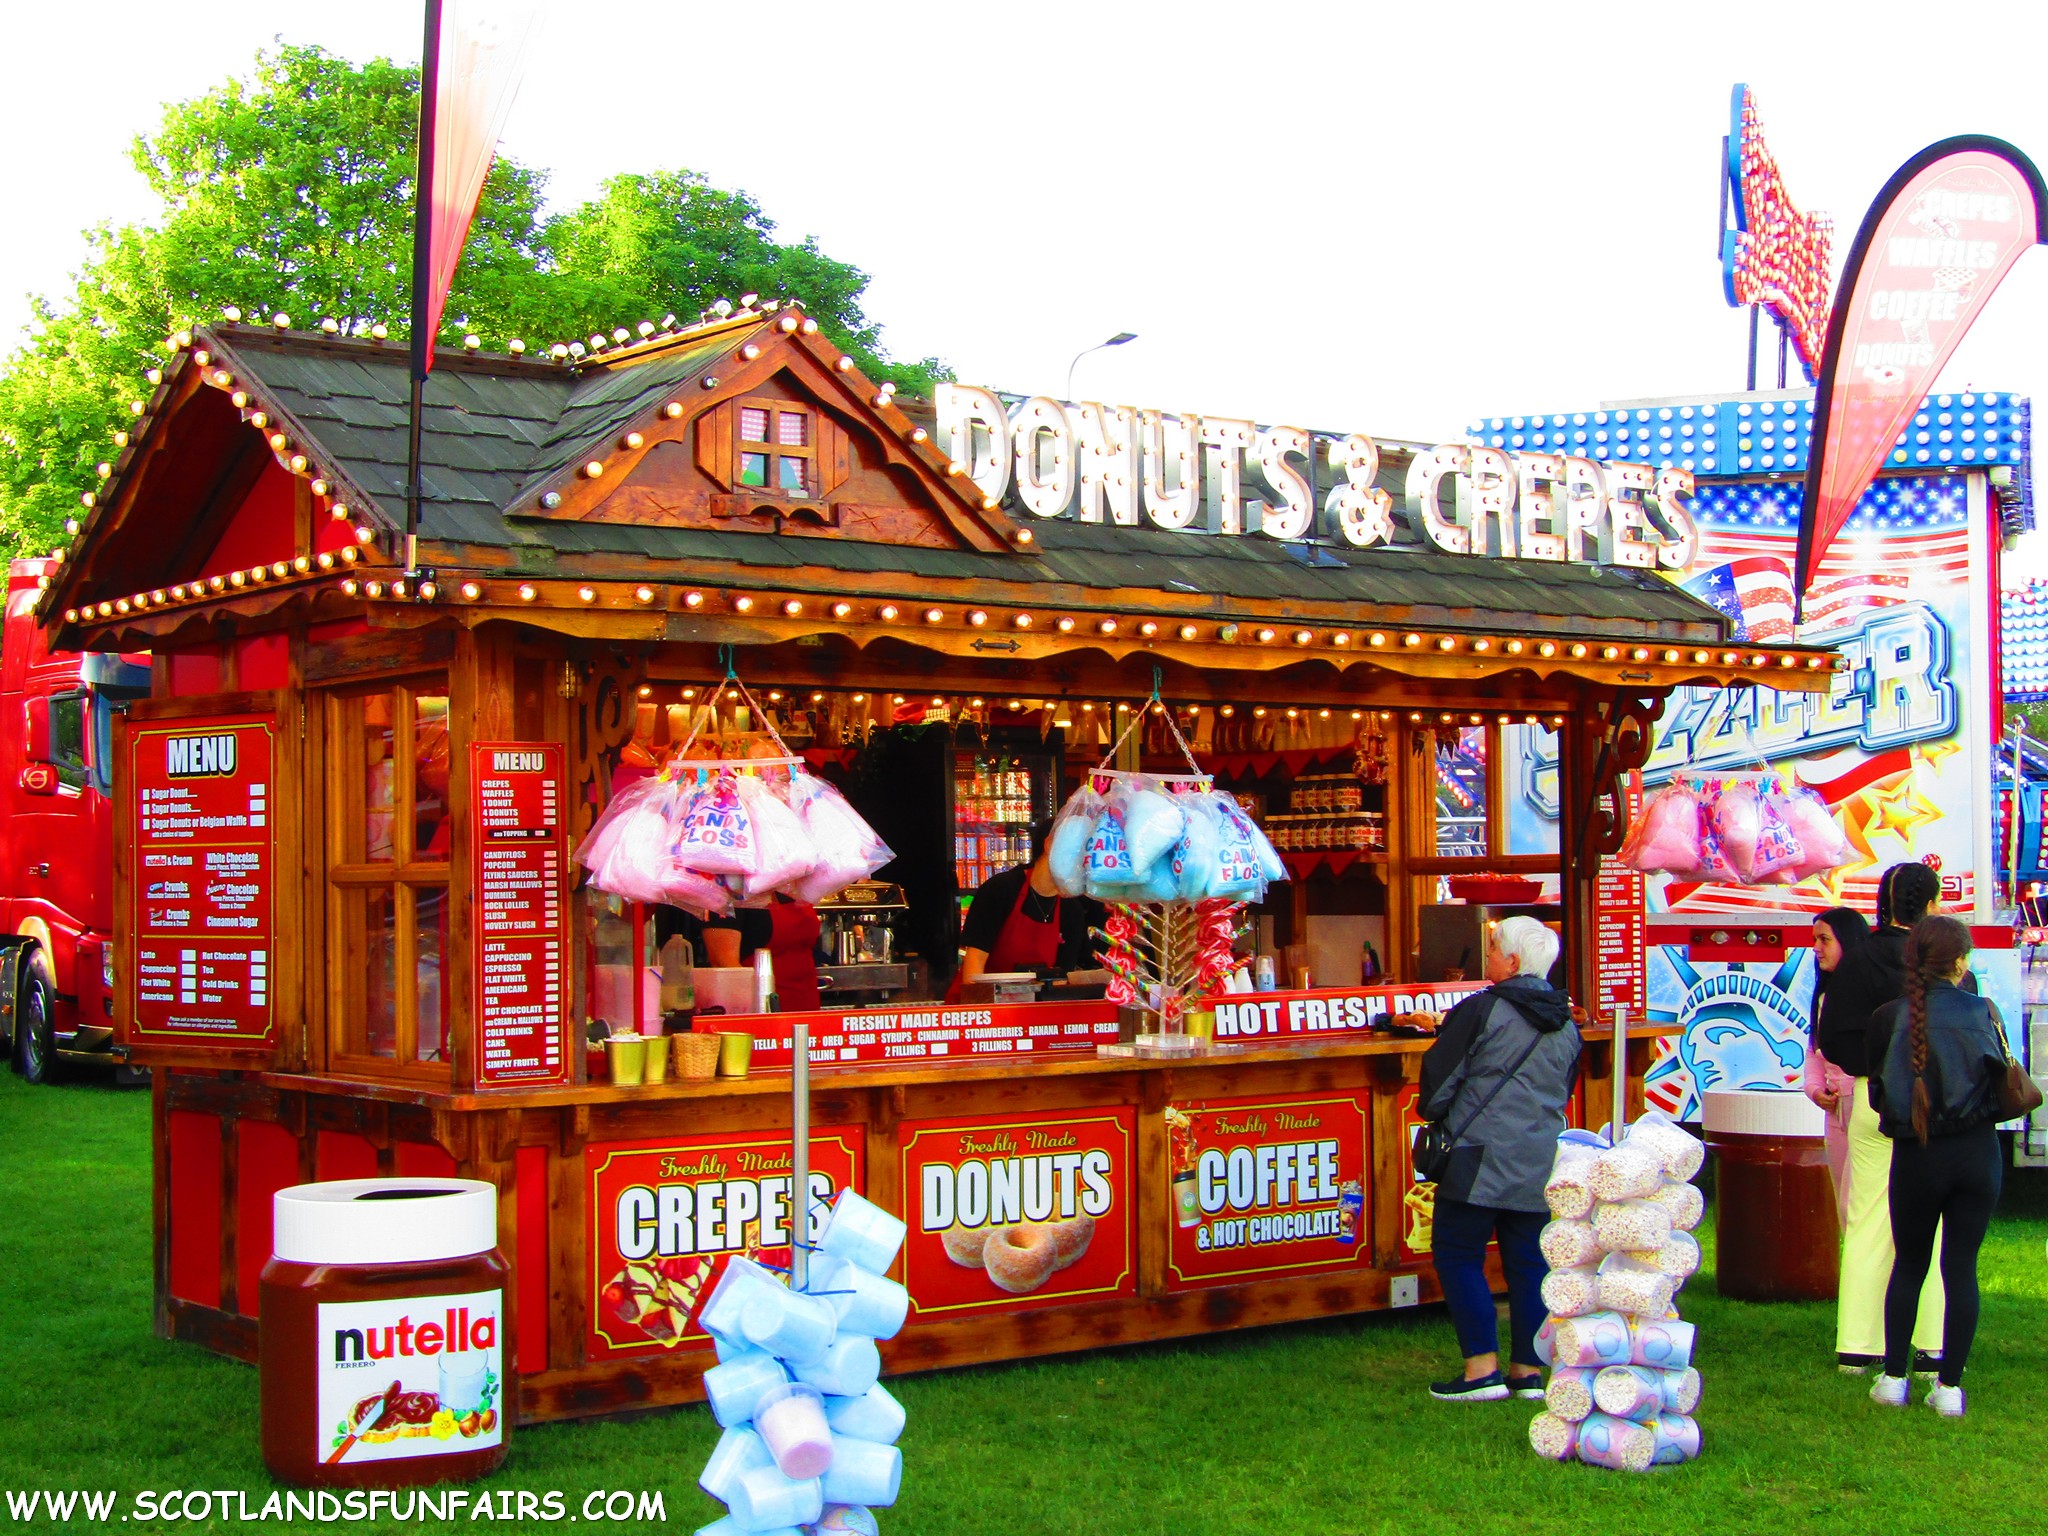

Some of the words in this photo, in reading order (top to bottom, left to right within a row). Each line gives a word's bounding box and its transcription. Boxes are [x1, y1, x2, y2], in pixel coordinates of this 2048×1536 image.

[1925, 191, 2013, 222] CREPES
[1887, 237, 1997, 268] WAFFLES
[1870, 290, 1956, 320] COFFEE
[1855, 342, 1934, 367] DONUTS
[935, 382, 1313, 539] DONUTS
[1325, 433, 1395, 546] &
[1405, 443, 1699, 570] CREPES
[168, 735, 235, 774] MENU
[493, 752, 544, 771] MENU
[482, 780, 510, 788] CREPES
[152, 788, 169, 800] Sugar
[482, 789, 514, 798] WAFFLES
[482, 799, 487, 807] 1
[488, 799, 513, 807] DONUT
[152, 803, 169, 815] Sugar
[488, 808, 518, 817] DONUTS
[152, 818, 169, 829] Sugar
[170, 817, 191, 828] Donuts
[192, 819, 199, 828] or
[226, 815, 247, 827] Waffle
[483, 818, 488, 826] 3
[489, 818, 519, 826] DONUTS
[684, 811, 748, 832] CANDY
[680, 829, 748, 849] FLOSS
[1085, 835, 1126, 852] CAN
[207, 853, 225, 864] White
[226, 852, 259, 863] Chocolate
[483, 850, 526, 859] CANDYFLOSS
[1219, 848, 1256, 864] CAN
[167, 857, 172, 866] &
[172, 855, 193, 866] Cream
[484, 861, 516, 869] POPCORN
[1082, 852, 1132, 869] FLOS
[484, 871, 506, 880] FLYING
[506, 870, 538, 879] SAUCERS
[165, 881, 188, 892] Crumbs
[227, 883, 259, 895] Chocolate
[484, 881, 508, 890] MARSH
[509, 880, 543, 889] MALLOWS
[484, 891, 517, 900] DUMMIES
[484, 902, 504, 910] ROCK
[504, 901, 530, 909] LOLLIES
[167, 909, 190, 920] Crumbs
[484, 912, 507, 920] SLUSH
[206, 915, 238, 927] Cinnamon
[239, 915, 258, 928] Sugar
[484, 922, 513, 930] NOVELTY
[513, 920, 536, 929] SLUSH
[484, 943, 506, 952] LATTE
[141, 951, 156, 959] Latte
[202, 951, 213, 960] Hot
[213, 952, 247, 960] Chocolate
[484, 953, 532, 962] CAPPUCCINO
[141, 964, 176, 974] Cappuccino
[202, 965, 214, 974] Tea
[484, 964, 522, 973] ESPRESSO
[141, 978, 152, 987] Flat
[152, 979, 171, 987] White
[202, 980, 217, 988] Cold
[217, 980, 239, 989] Drinks
[484, 975, 501, 984] FLAT
[502, 974, 526, 983] WHITE
[484, 985, 528, 994] AMERICANO
[141, 992, 174, 1001] Americano
[202, 994, 222, 1002] Water
[485, 996, 498, 1005] TEA
[485, 1007, 501, 1016] HOT
[501, 1005, 543, 1015] CHOCOLATE
[1215, 1001, 1281, 1037] HOT
[1288, 995, 1387, 1032] FRESH
[842, 1015, 898, 1032] FRESHLY
[901, 1013, 939, 1029] MADE
[941, 1010, 992, 1027] CREPES
[485, 1028, 505, 1037] COLD
[505, 1026, 533, 1036] DRINKS
[754, 1038, 777, 1050] TELLA
[783, 1036, 817, 1050] BIFF
[822, 1035, 844, 1047] OREO
[848, 1034, 876, 1046] SUGAR
[881, 1032, 912, 1044] SYRUPS
[917, 1029, 960, 1042] CINNAMON
[964, 1026, 1024, 1040] STRAWBERRIES
[1028, 1024, 1059, 1036] BANANA
[1063, 1023, 1089, 1035] LEMON
[485, 1039, 506, 1048] CANS
[971, 1041, 978, 1053] 3
[979, 1039, 1012, 1052] FILLINGS
[485, 1049, 511, 1059] WATER
[885, 1047, 891, 1057] 2
[892, 1043, 926, 1056] FILLINGS
[486, 1060, 513, 1070] SIMPLY
[513, 1058, 539, 1067] FRUITS
[1214, 1115, 1268, 1138] Freshly
[1274, 1112, 1320, 1130] Made
[958, 1133, 1018, 1157] Freshly
[1027, 1131, 1077, 1149] Made
[659, 1153, 728, 1180] Freshly
[736, 1150, 793, 1172] Made
[1198, 1140, 1339, 1212] COFFEE
[922, 1152, 1112, 1230] DONUTS
[1197, 1227, 1210, 1249] &
[1213, 1219, 1246, 1247] HOT
[1249, 1209, 1341, 1242] CHOCOLATE
[335, 1307, 496, 1362] nutella
[335, 1360, 376, 1369] FERRERO
